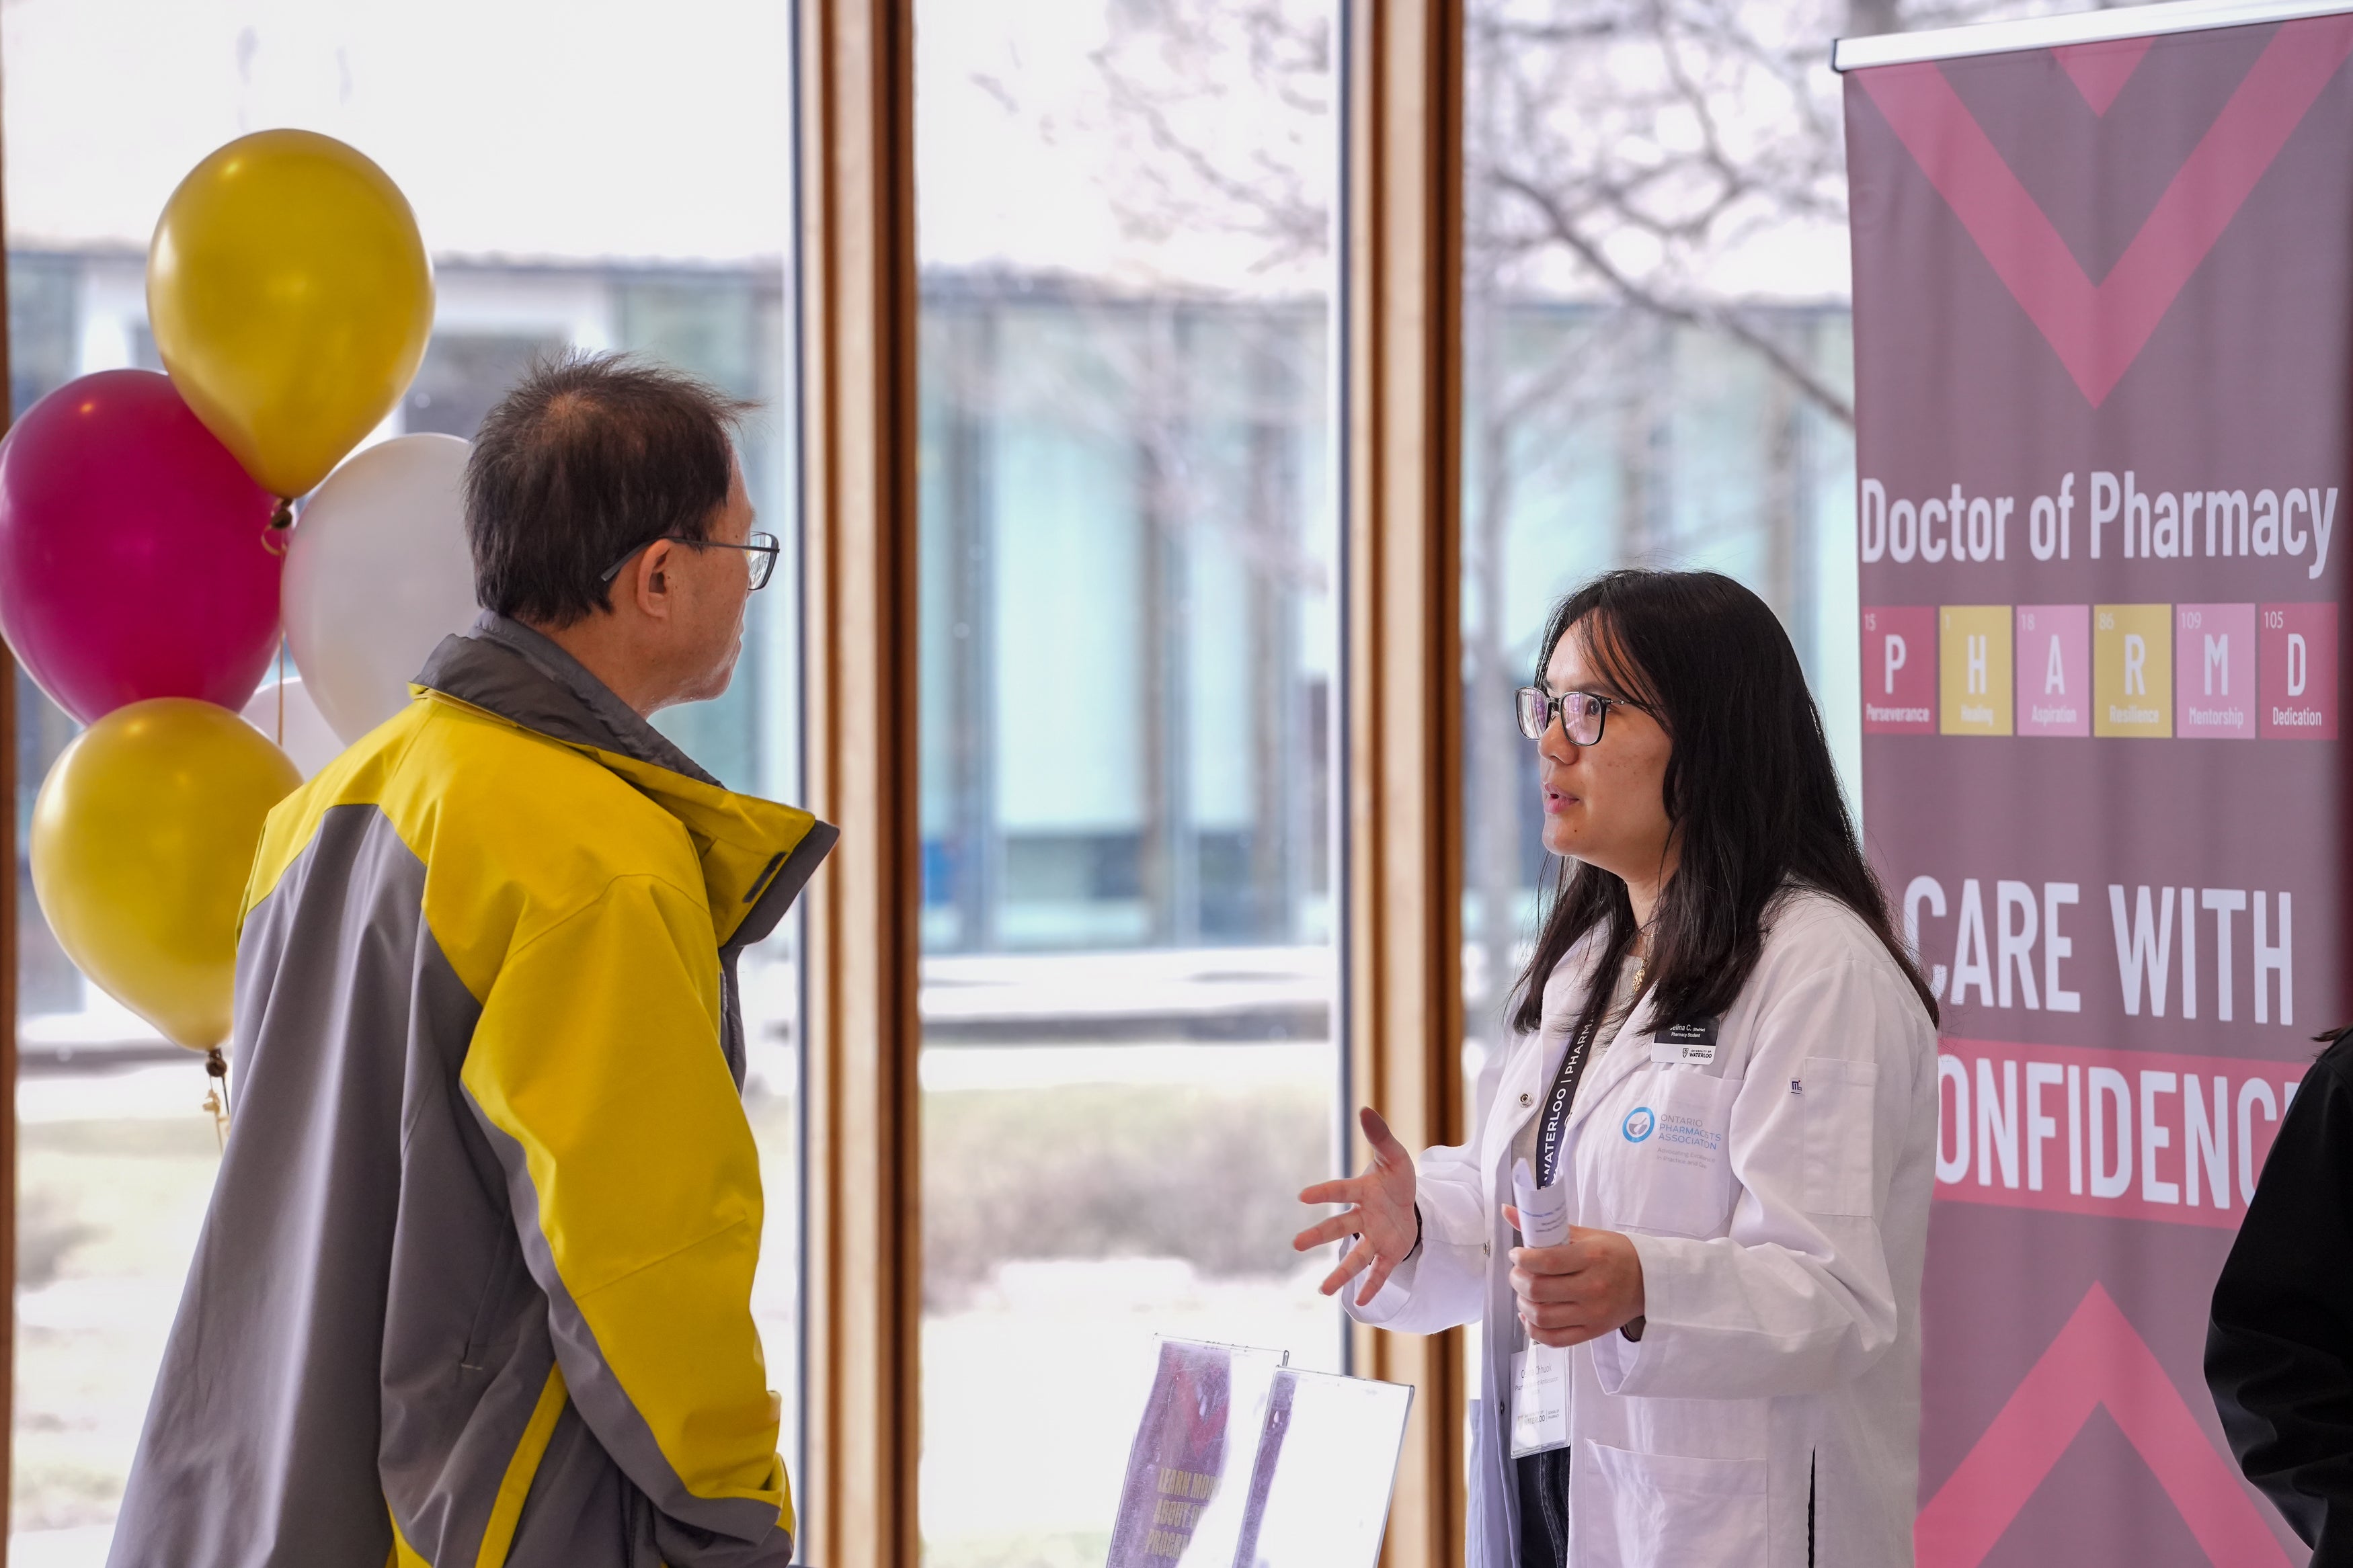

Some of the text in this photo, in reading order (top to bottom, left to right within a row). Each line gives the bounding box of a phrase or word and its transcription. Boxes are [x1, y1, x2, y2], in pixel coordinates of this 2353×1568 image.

[1861, 470, 2338, 579] Doctor of Pharmacy
[1864, 614, 1876, 631] 15
[2022, 614, 2035, 630] 18
[2099, 612, 2114, 630] 86
[2182, 612, 2202, 629] 109
[2264, 611, 2283, 628] 105
[1885, 633, 2306, 696] P H A R M D
[1866, 703, 1929, 723] Perseverance
[1960, 704, 1993, 727] Healing
[2031, 705, 2077, 726] Aspiration
[2109, 705, 2159, 725] Resilience
[2189, 707, 2243, 729] Mentorship
[2273, 707, 2321, 726] Dedication
[1904, 875, 2293, 1026] CARE WITH
[1564, 1018, 1593, 1075] PHARM
[1661, 1114, 1703, 1127] ONTARIO
[1658, 1132, 1717, 1150] ASSOCIATON
[1936, 1054, 2299, 1210] ONFIDENC
[1657, 1147, 1689, 1158] Advocating
[1157, 1467, 1221, 1500] LEARN MOR
[1153, 1499, 1191, 1528] ABOUT
